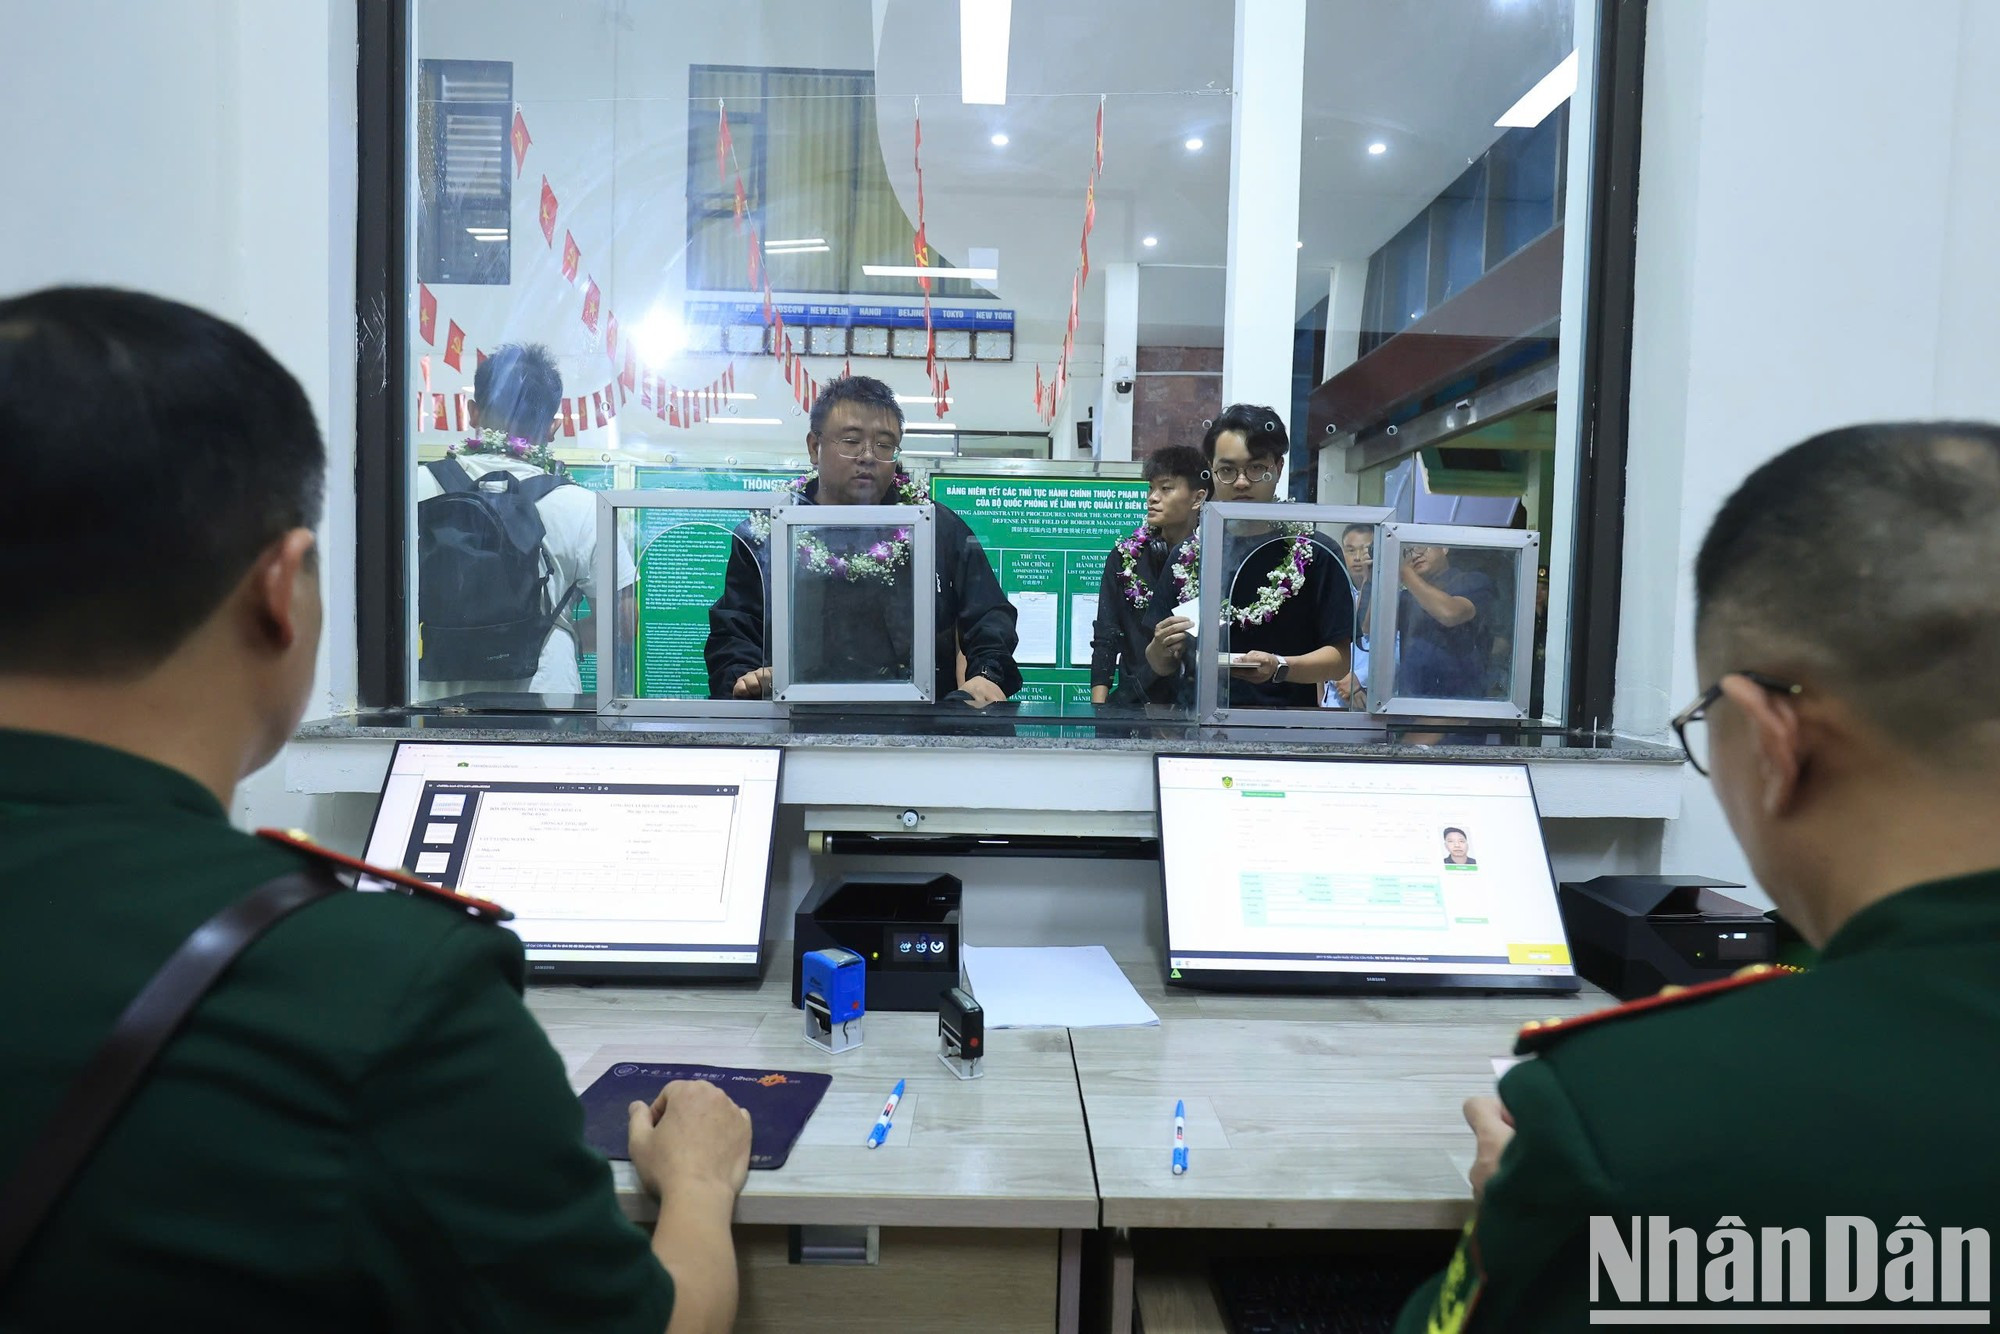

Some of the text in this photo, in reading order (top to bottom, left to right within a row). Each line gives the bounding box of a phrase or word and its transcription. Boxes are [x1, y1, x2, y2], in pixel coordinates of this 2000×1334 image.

[810, 306, 849, 315] NEW DELHI
[860, 308, 881, 316] HANOI
[942, 310, 964, 318] TOKYO
[976, 311, 1012, 320] NEW YORK
[947, 485, 1147, 500] BẢNG NIÊM YẾT CÁC THỦ TỤC HÀNH CHÍNH THUỘC PHẠM VI
[976, 497, 990, 506] CỦA
[992, 499, 1002, 508] BỘ
[1003, 498, 1022, 507] QUỐC
[1024, 499, 1048, 508] PHÒNG
[1050, 498, 1058, 508] VỀ
[1060, 499, 1076, 508] LĨNH
[1078, 501, 1092, 510] VỰC
[1094, 499, 1113, 509] QUẢN
[1115, 500, 1123, 509] LÝ
[1125, 500, 1142, 510] BIÊN
